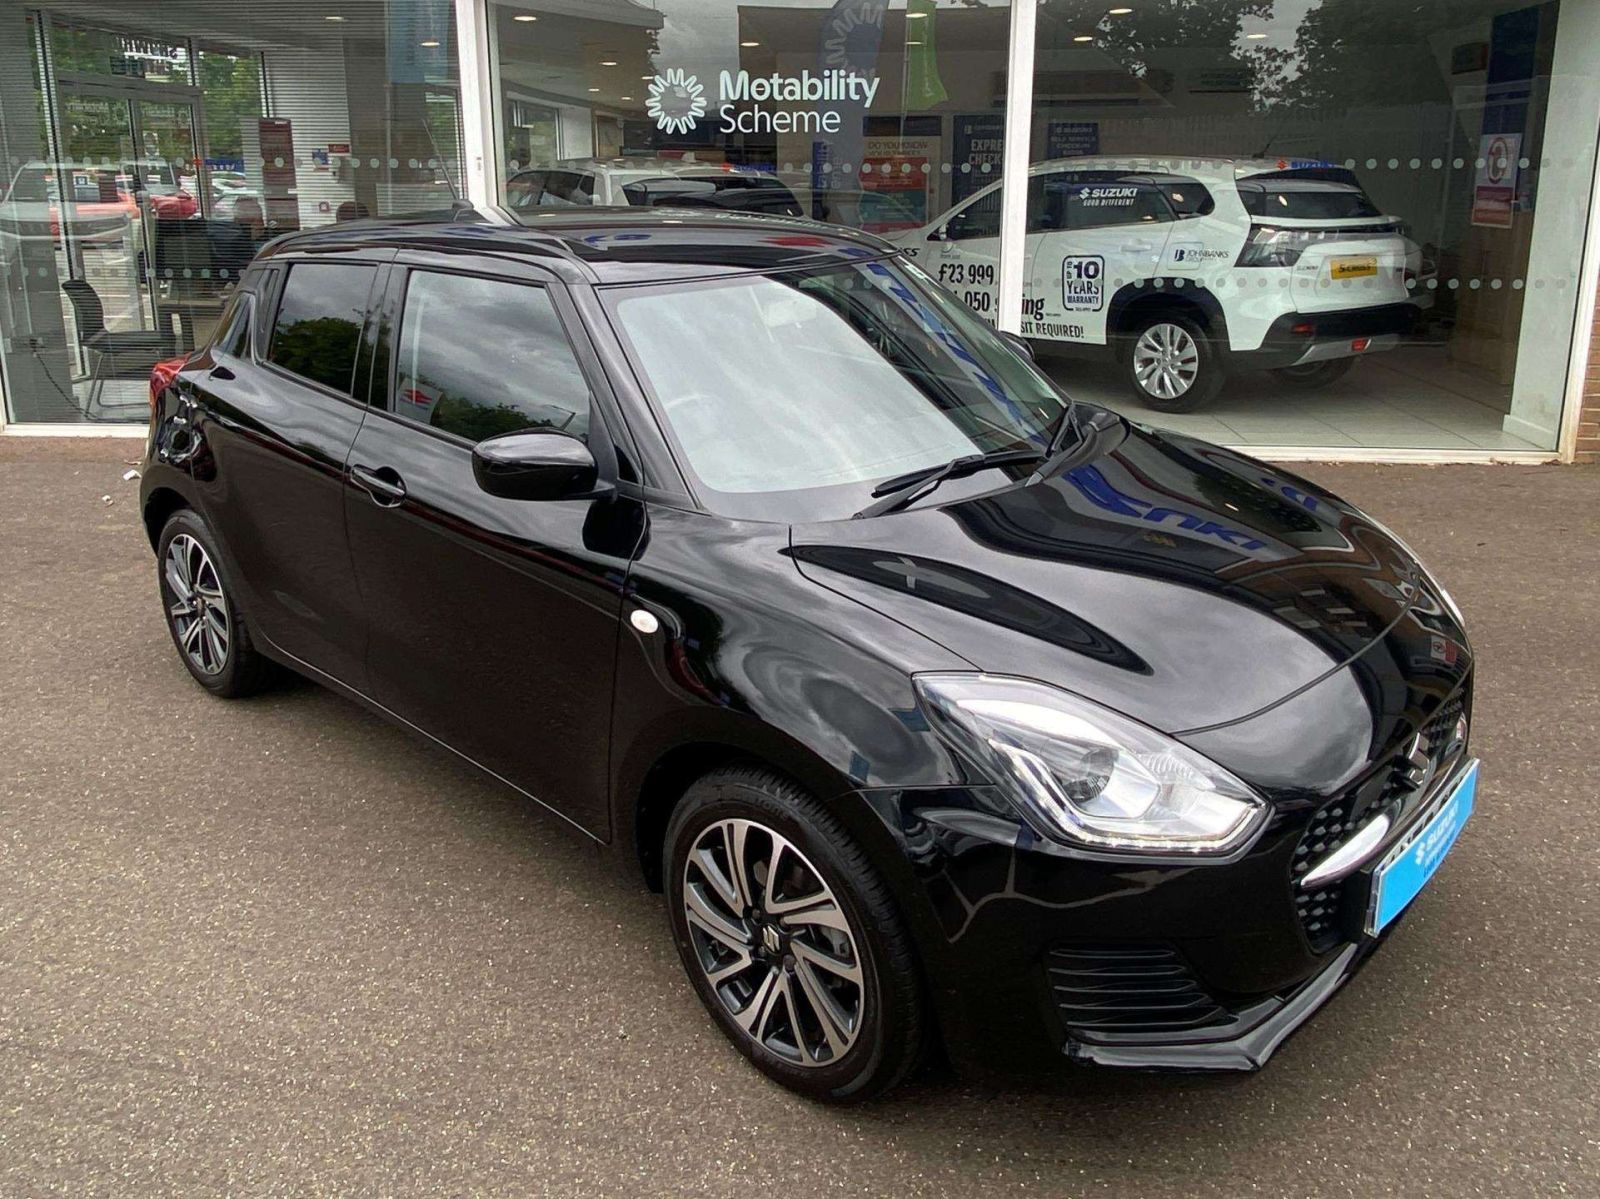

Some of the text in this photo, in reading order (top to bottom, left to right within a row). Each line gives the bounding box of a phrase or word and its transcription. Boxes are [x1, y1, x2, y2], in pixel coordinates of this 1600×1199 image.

[720, 70, 880, 108] Motability
[720, 104, 841, 133] Scheme
[1092, 188, 1138, 198] SUZUKI
[1073, 261, 1100, 279] 10
[1066, 280, 1100, 295] YEARS
[1067, 295, 1099, 304] WARRANTY
[1035, 322, 1084, 339] REQUIRED!
